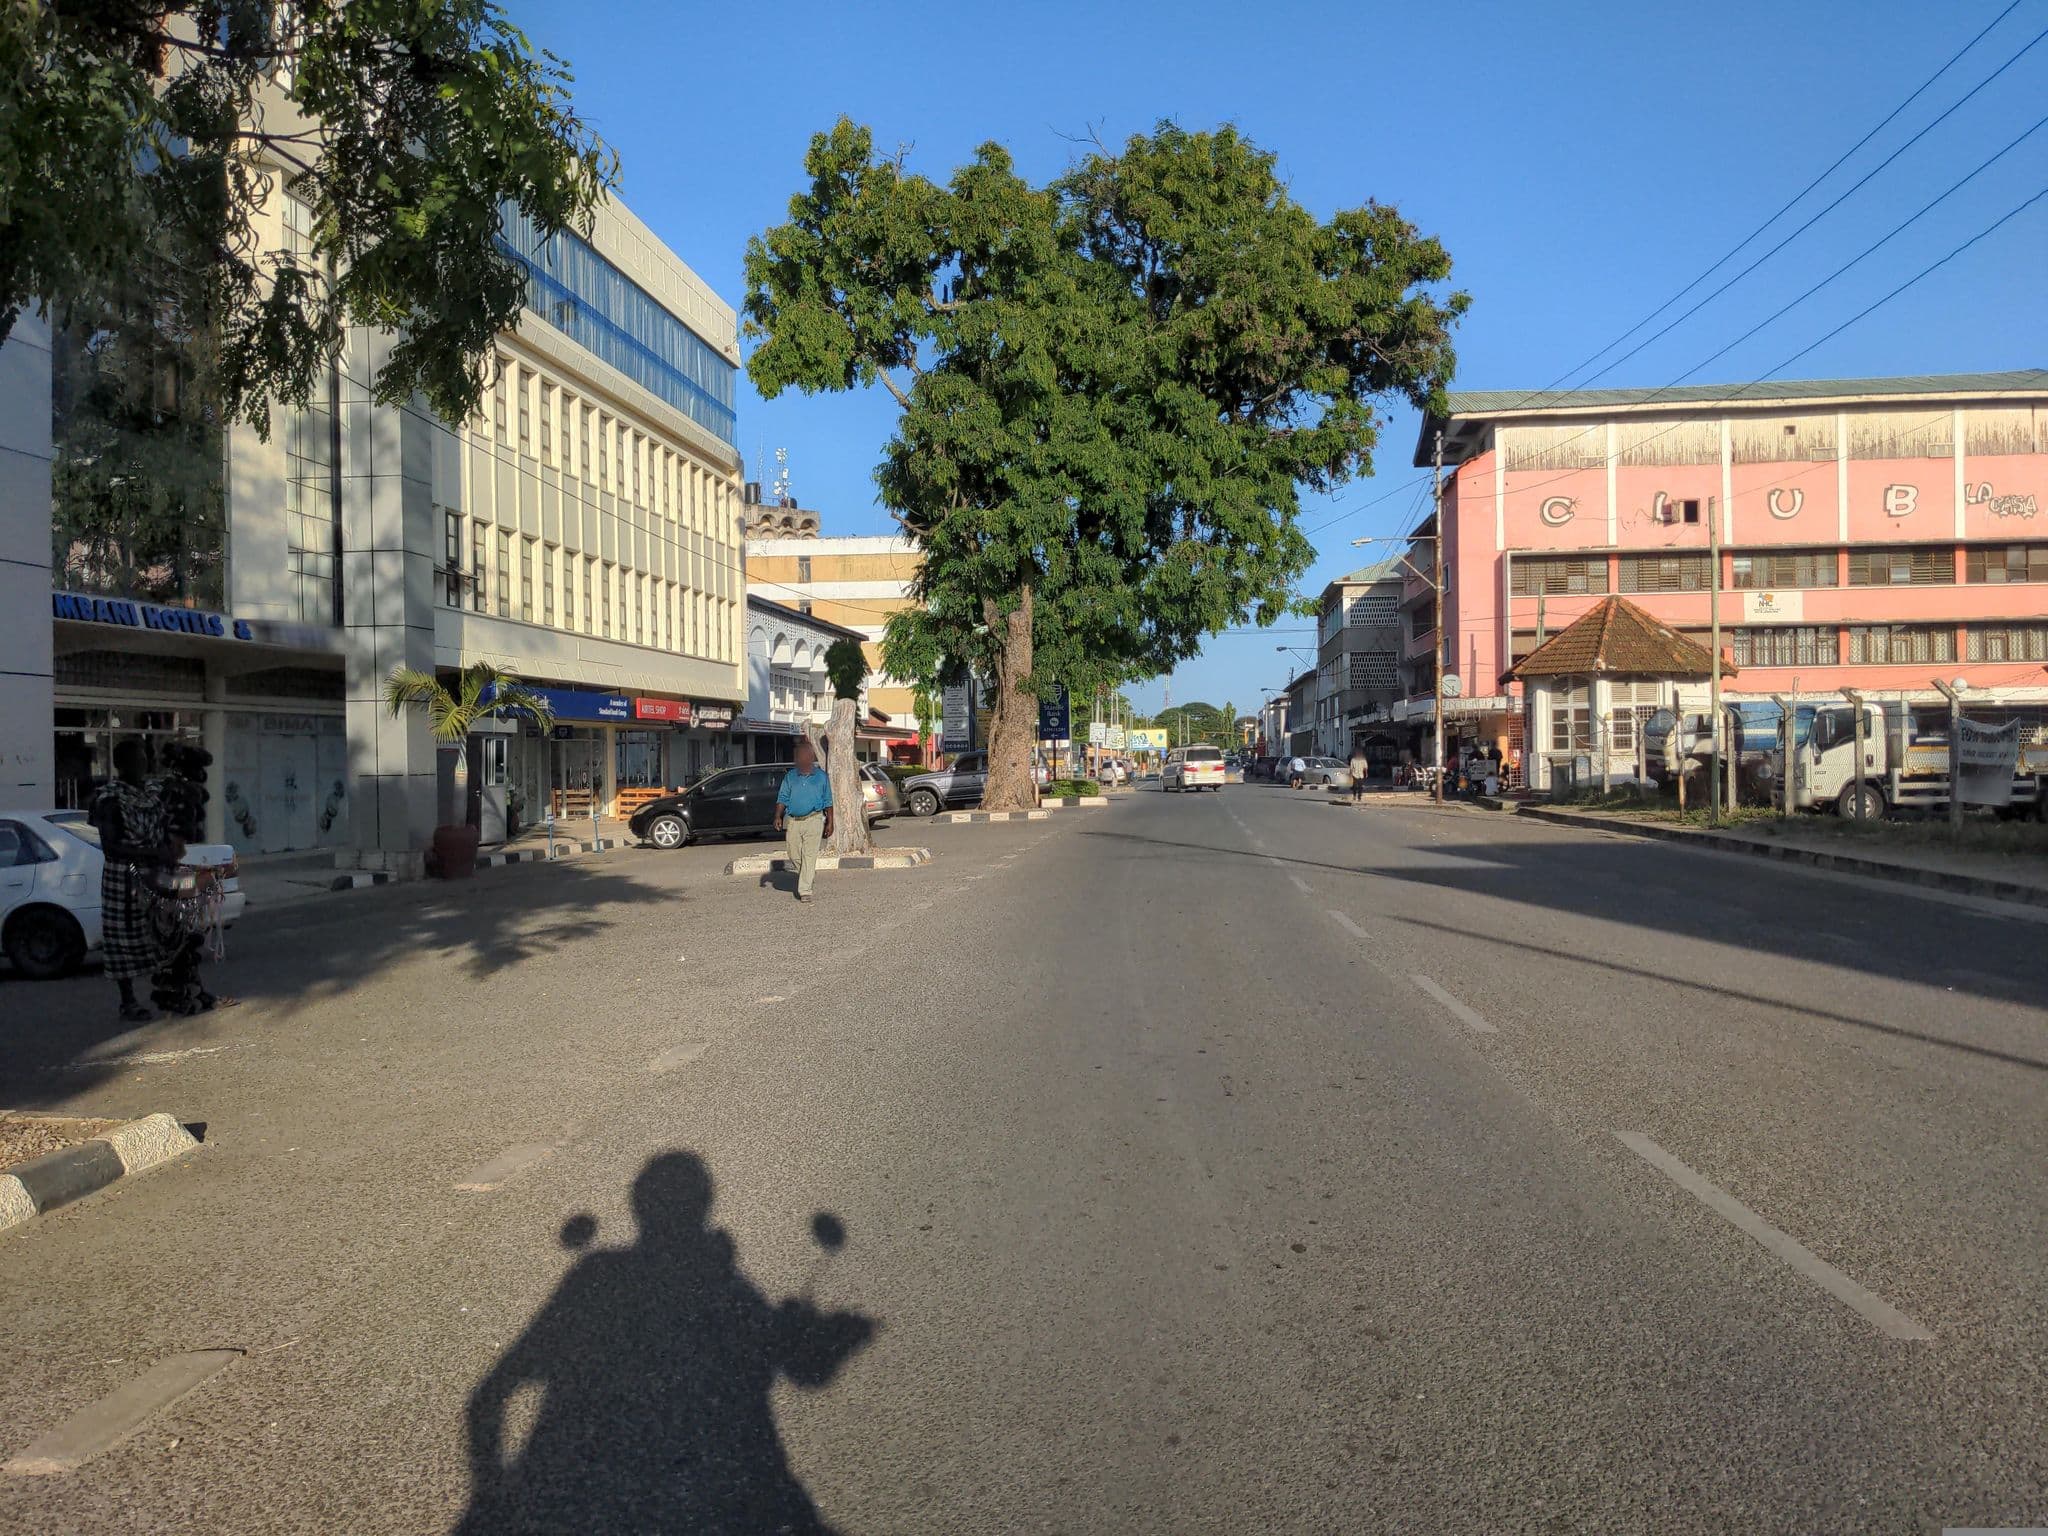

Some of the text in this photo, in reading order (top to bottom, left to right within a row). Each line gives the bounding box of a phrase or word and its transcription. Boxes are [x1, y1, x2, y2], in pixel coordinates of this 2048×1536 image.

[1989, 494, 2038, 520] CASA
[142, 606, 225, 637] HOTELS
[233, 619, 252, 641] &
[656, 705, 667, 715] SHOP
